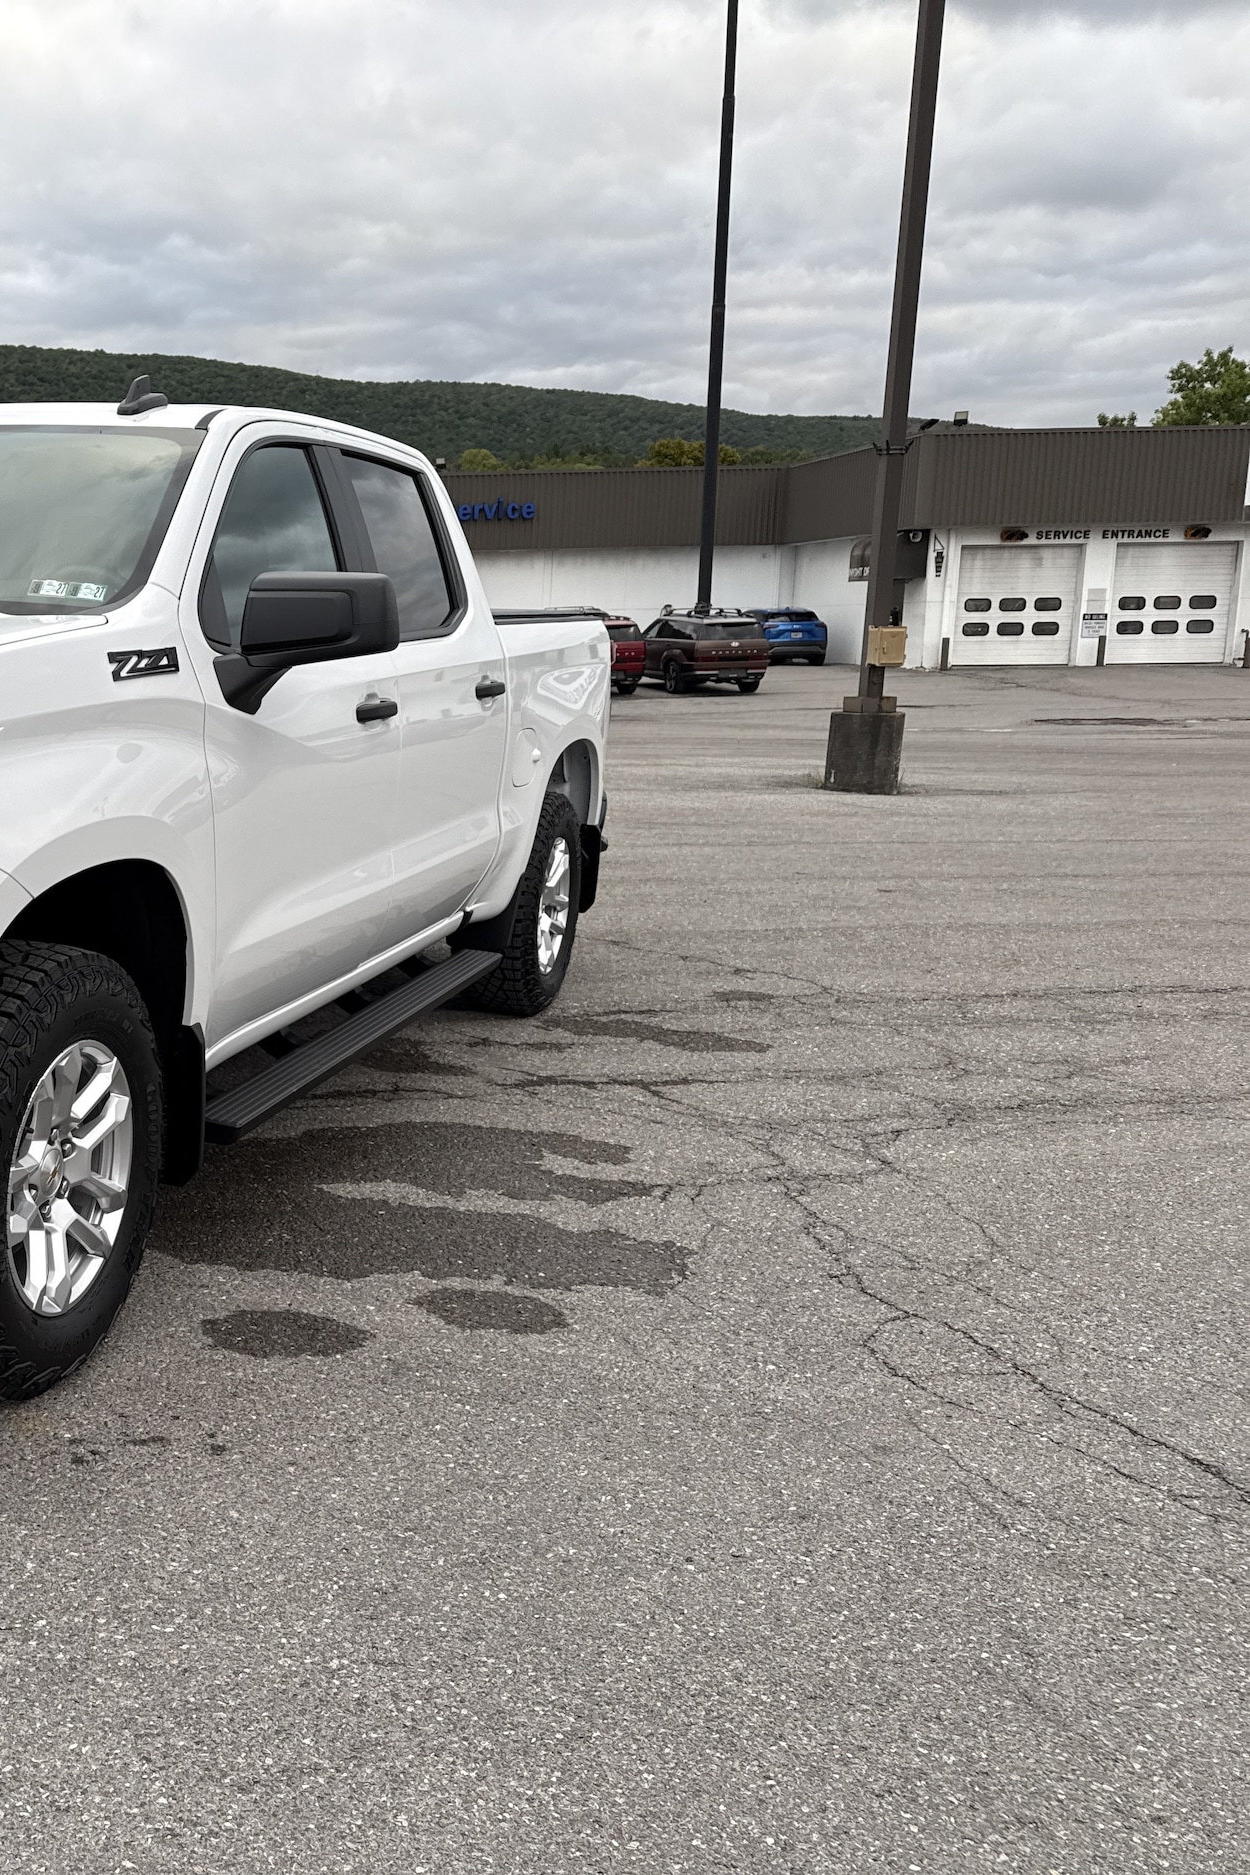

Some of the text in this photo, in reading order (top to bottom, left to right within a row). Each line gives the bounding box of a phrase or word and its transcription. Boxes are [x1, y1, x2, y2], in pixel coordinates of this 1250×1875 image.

[457, 496, 536, 521] ervice
[1035, 529, 1170, 540] SERVICE ENTRANCE
[55, 583, 68, 595] 27
[93, 586, 105, 599] 27
[107, 646, 180, 682] Z71
